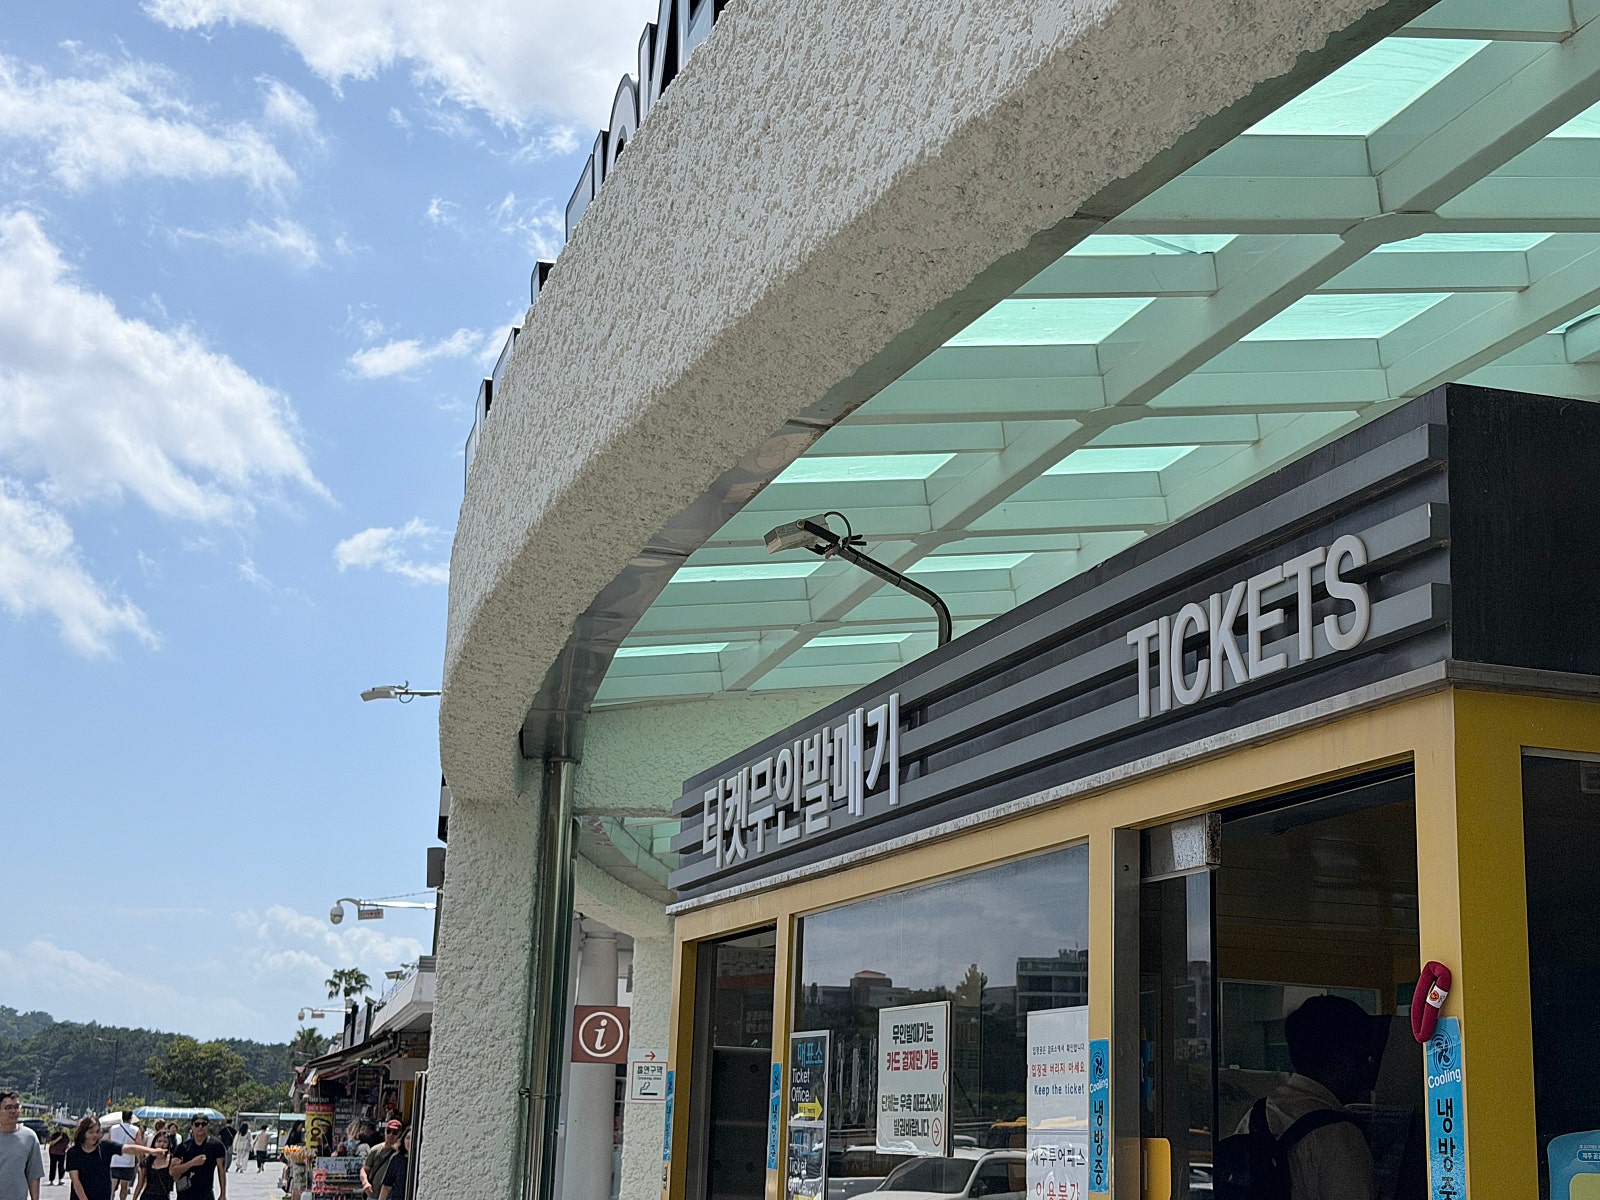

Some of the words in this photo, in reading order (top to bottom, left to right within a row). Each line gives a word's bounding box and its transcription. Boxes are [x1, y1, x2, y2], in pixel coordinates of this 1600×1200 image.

[1126, 534, 1370, 719] TICKETS
[892, 1022, 934, 1045] 무인발매기는
[797, 1041, 823, 1068] 매표소
[886, 1051, 901, 1072] 카드
[902, 1049, 923, 1071] 결제만
[924, 1048, 939, 1070] 가능
[792, 1068, 810, 1084] Ticket
[1031, 1063, 1047, 1078] 입장권
[1049, 1062, 1066, 1075] 버리지
[1428, 1068, 1462, 1089] Cooling
[790, 1086, 810, 1103] Office
[1034, 1084, 1050, 1098] Keep
[1052, 1083, 1062, 1096] the
[1064, 1083, 1085, 1095] ticket
[1089, 1078, 1109, 1094] Cooling
[900, 1093, 912, 1112] 우측
[912, 1093, 943, 1112] 매표소에서
[1093, 1100, 1104, 1186] 냉방중
[1436, 1097, 1457, 1200] 냉방중
[1035, 1180, 1081, 1200] 이용불가
